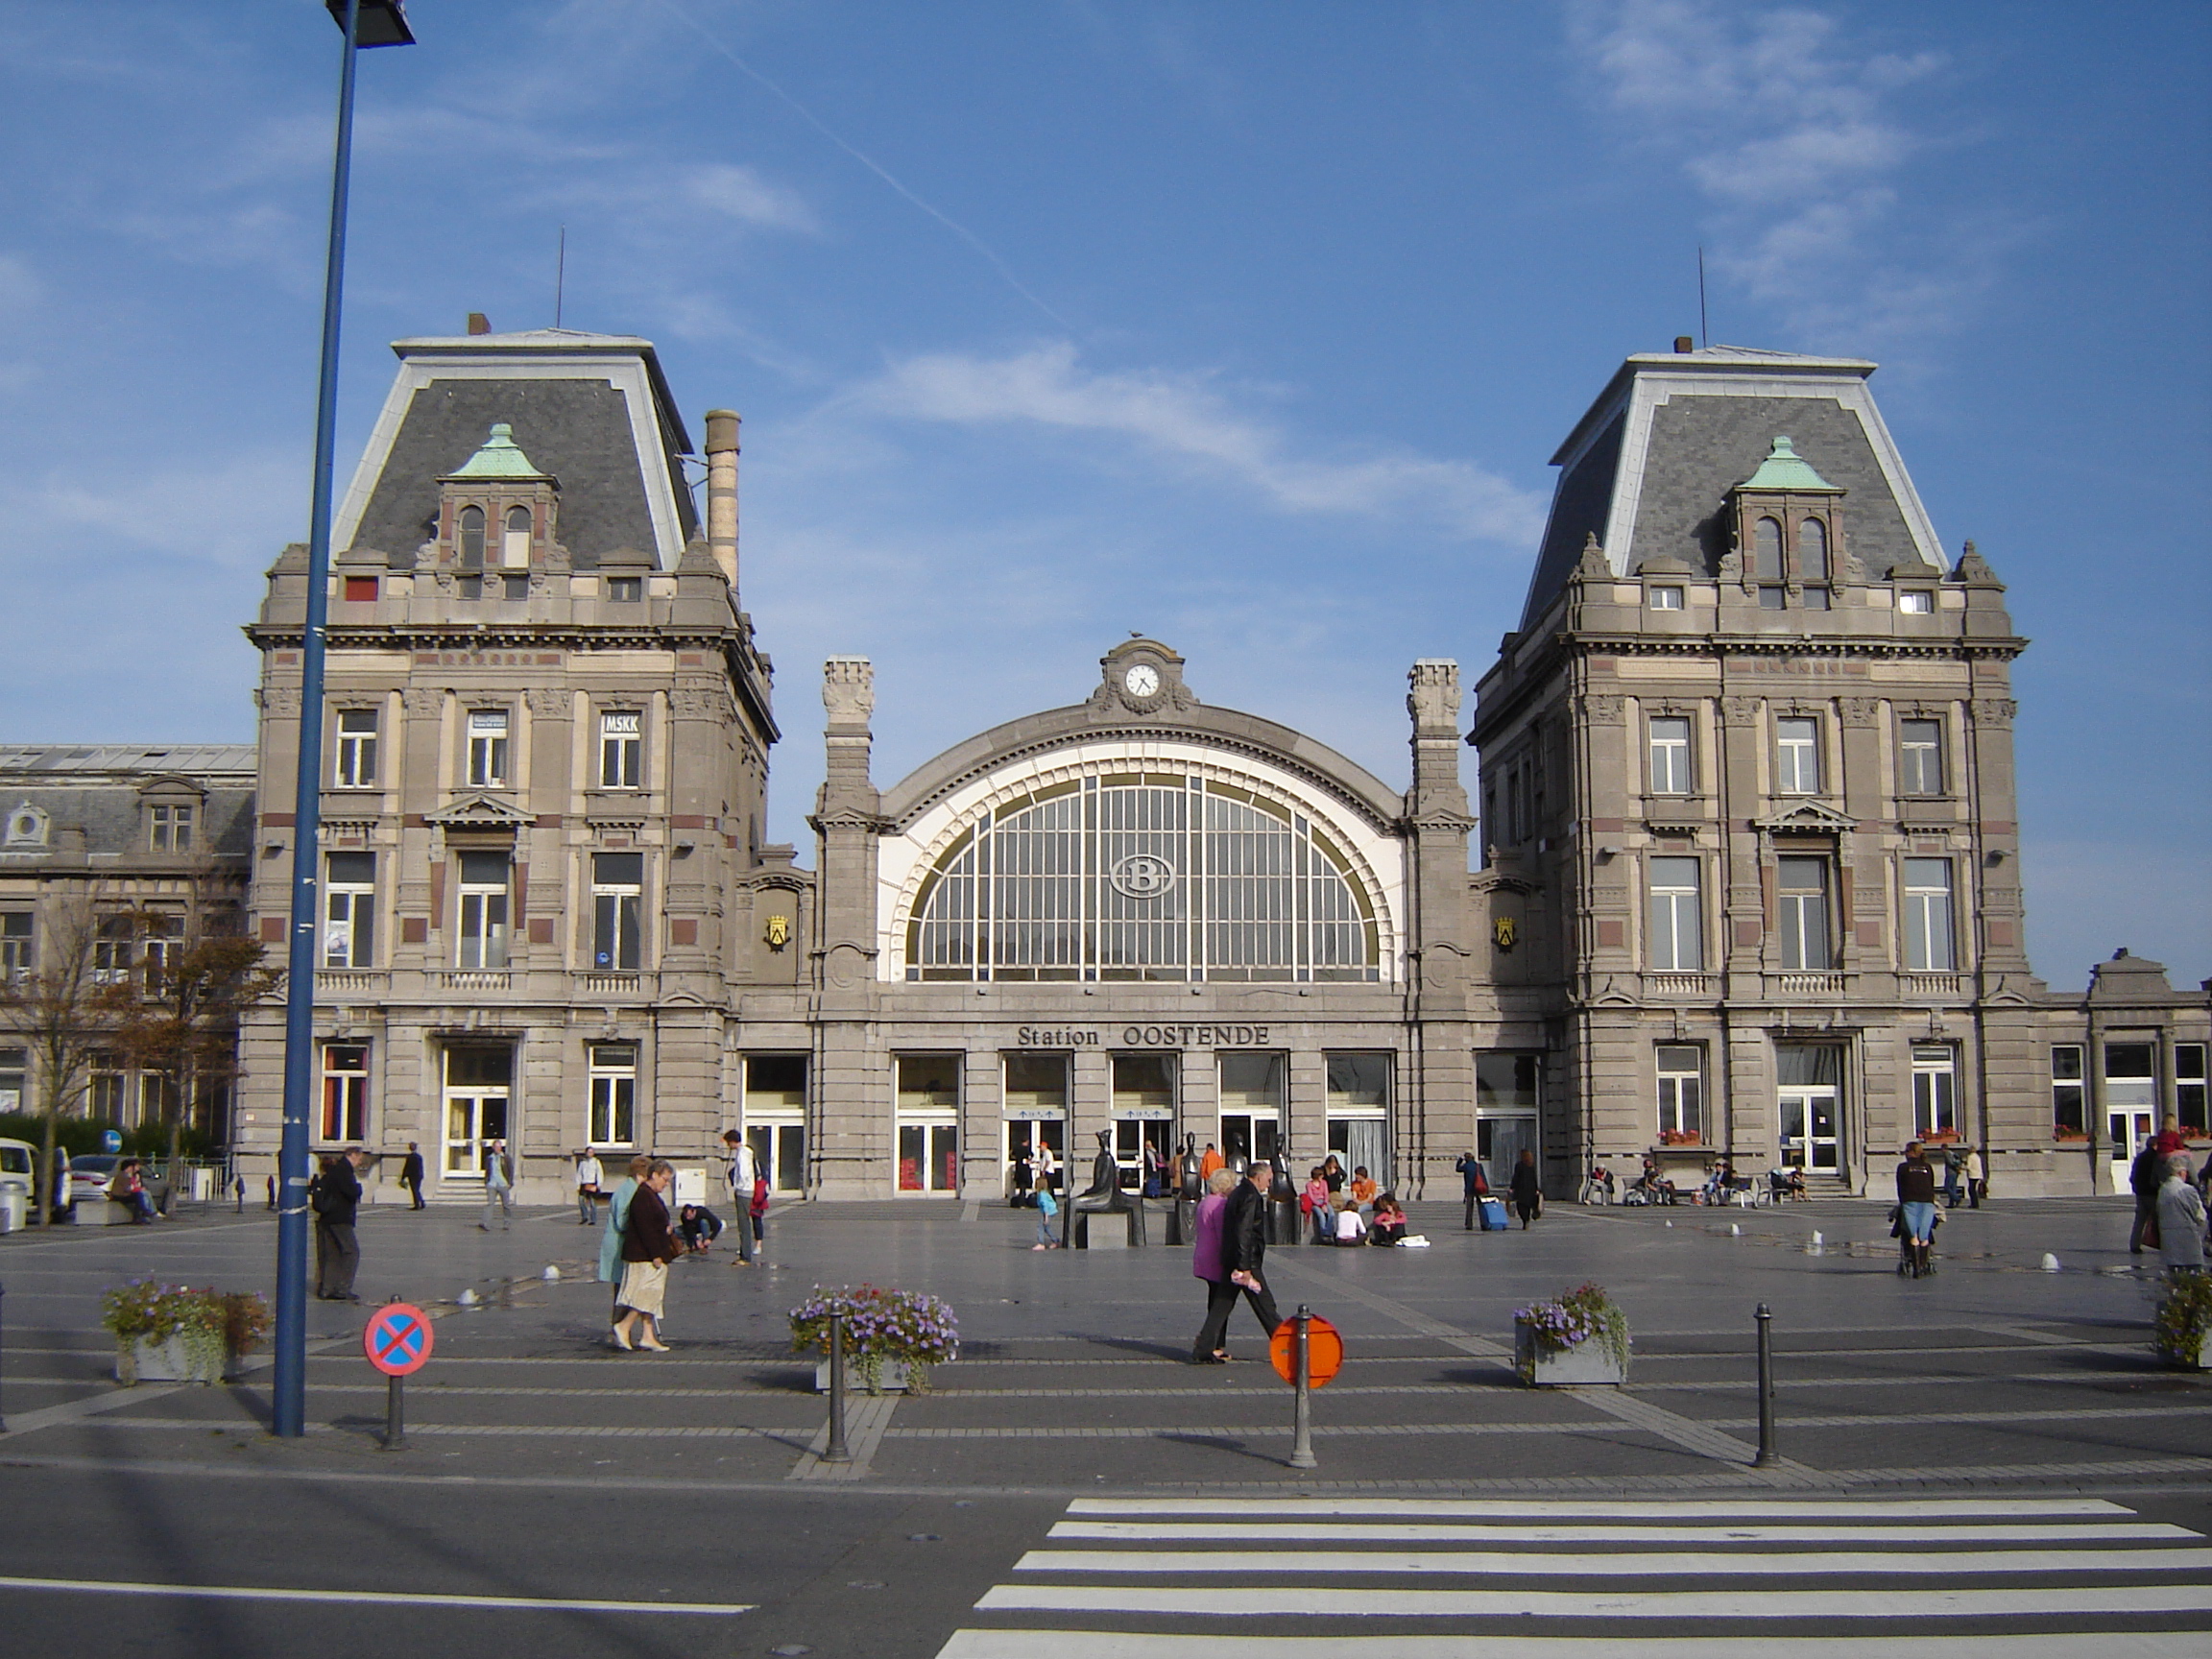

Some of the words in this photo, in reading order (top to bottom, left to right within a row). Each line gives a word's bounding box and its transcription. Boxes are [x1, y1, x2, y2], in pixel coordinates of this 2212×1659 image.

[606, 715, 638, 732] MSKK
[1127, 860, 1160, 892] B
[1018, 1025, 1099, 1046] Station
[1122, 1026, 1270, 1046] OOSTENDE
